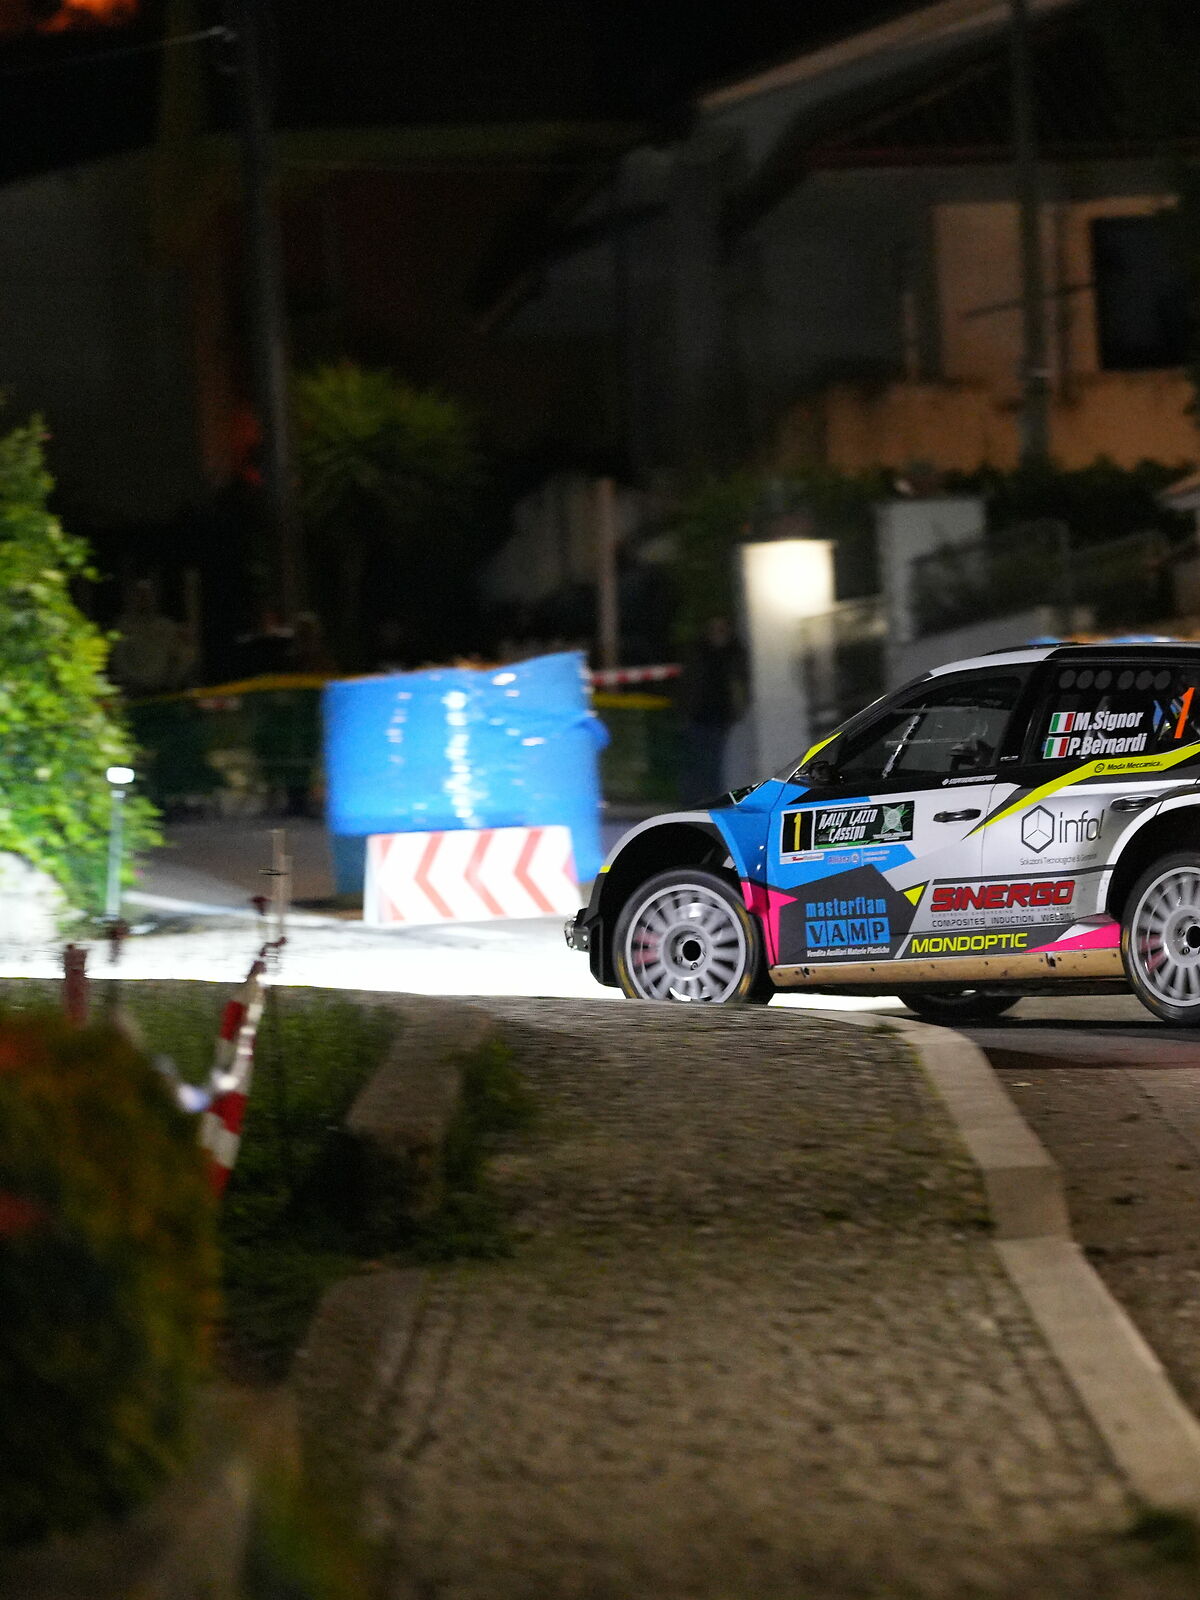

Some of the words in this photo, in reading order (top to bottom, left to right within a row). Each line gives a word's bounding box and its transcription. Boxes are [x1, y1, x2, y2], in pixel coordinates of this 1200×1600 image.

[1073, 711, 1145, 731] M.Signor
[1067, 732, 1148, 756] P.Bernardi
[1126, 761, 1161, 769] Meccanica
[818, 811, 847, 830] RALLY
[848, 808, 878, 826] LAZIO
[794, 812, 801, 851] 1
[828, 825, 866, 844] CASSINO
[930, 880, 1076, 912] SINERGO
[932, 917, 986, 928] COMPOSITES
[991, 914, 1035, 924] INDUCTION
[808, 920, 885, 945] VAMP
[911, 932, 1028, 954] MONDOPTIC
